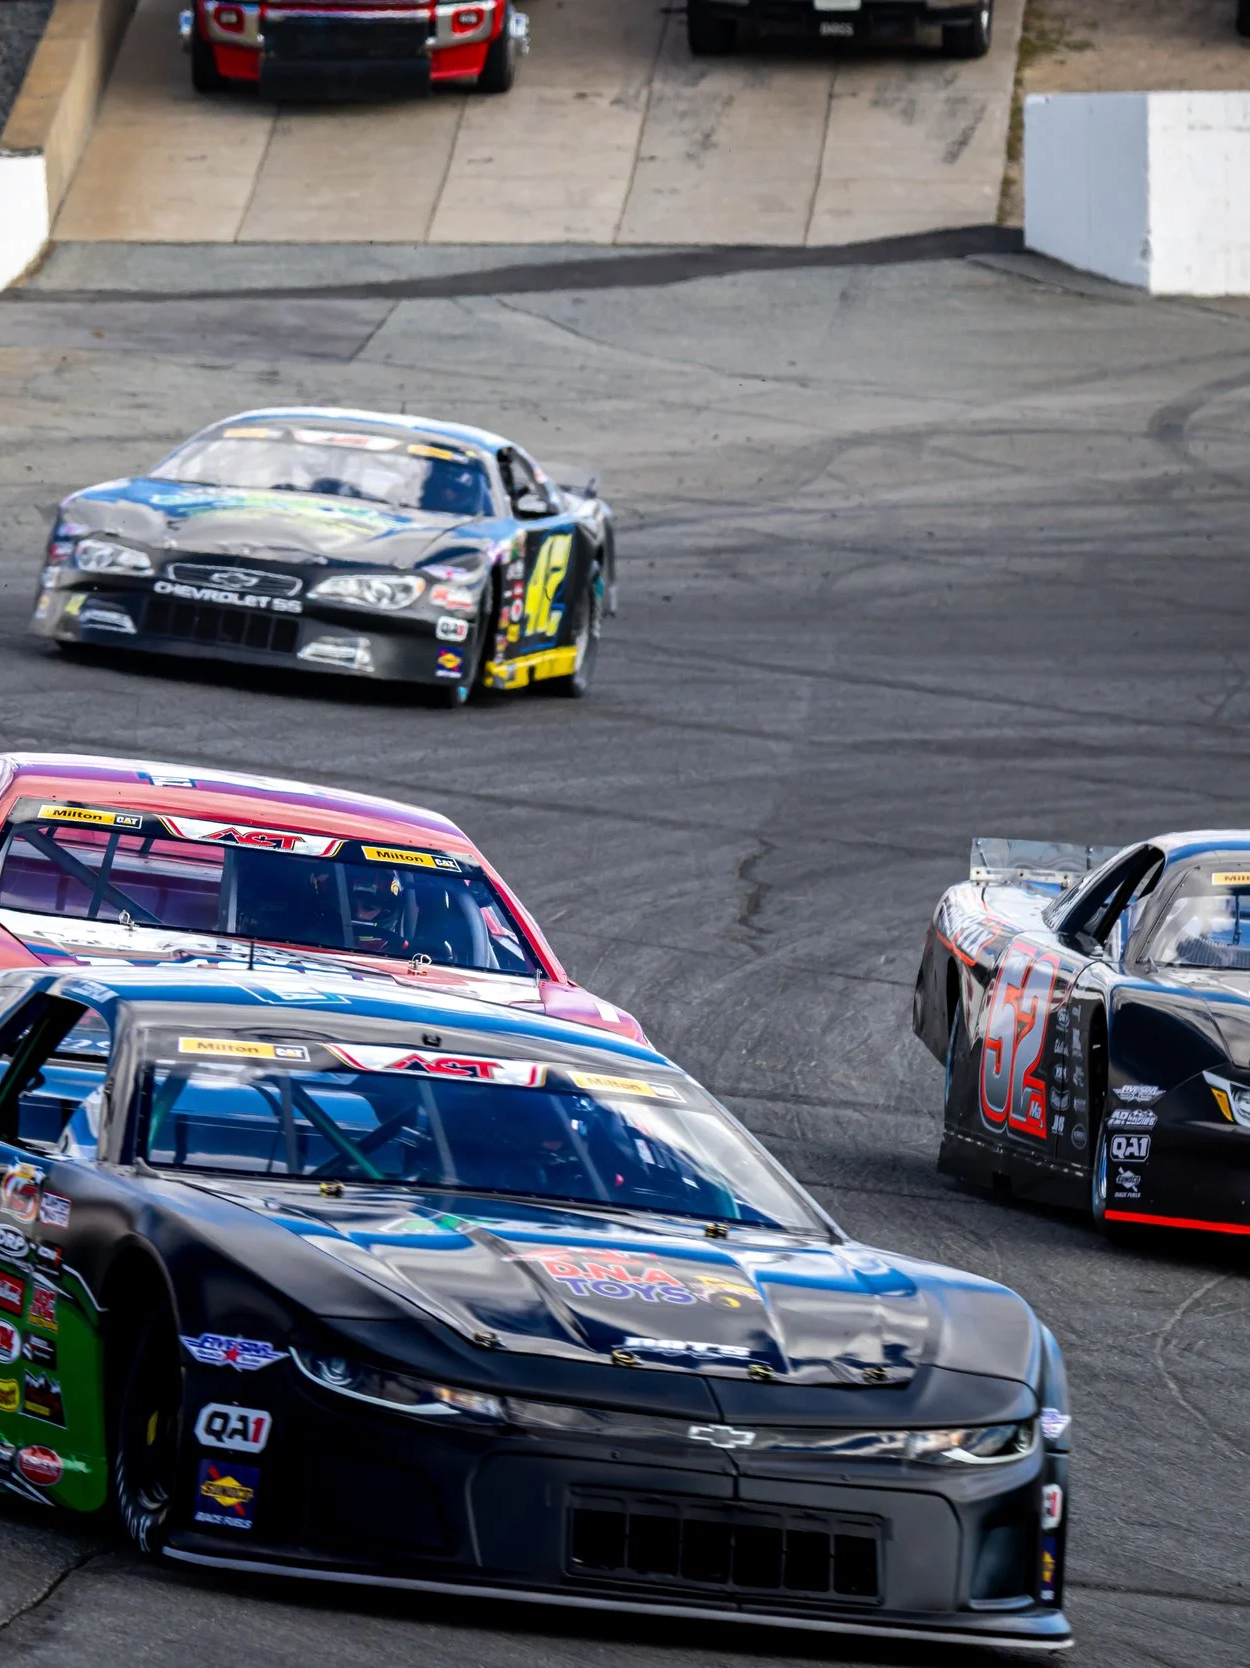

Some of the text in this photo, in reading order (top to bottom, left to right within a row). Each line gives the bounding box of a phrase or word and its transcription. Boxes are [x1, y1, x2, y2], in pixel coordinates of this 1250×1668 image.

[52, 808, 139, 826] Milton CAT
[375, 850, 425, 864] Milton
[196, 1041, 306, 1059] Milton CAT
[979, 940, 1061, 1140] 52
[1111, 1136, 1149, 1159] QA1
[554, 1277, 699, 1305] TOYS
[204, 1409, 265, 1444] QA1
